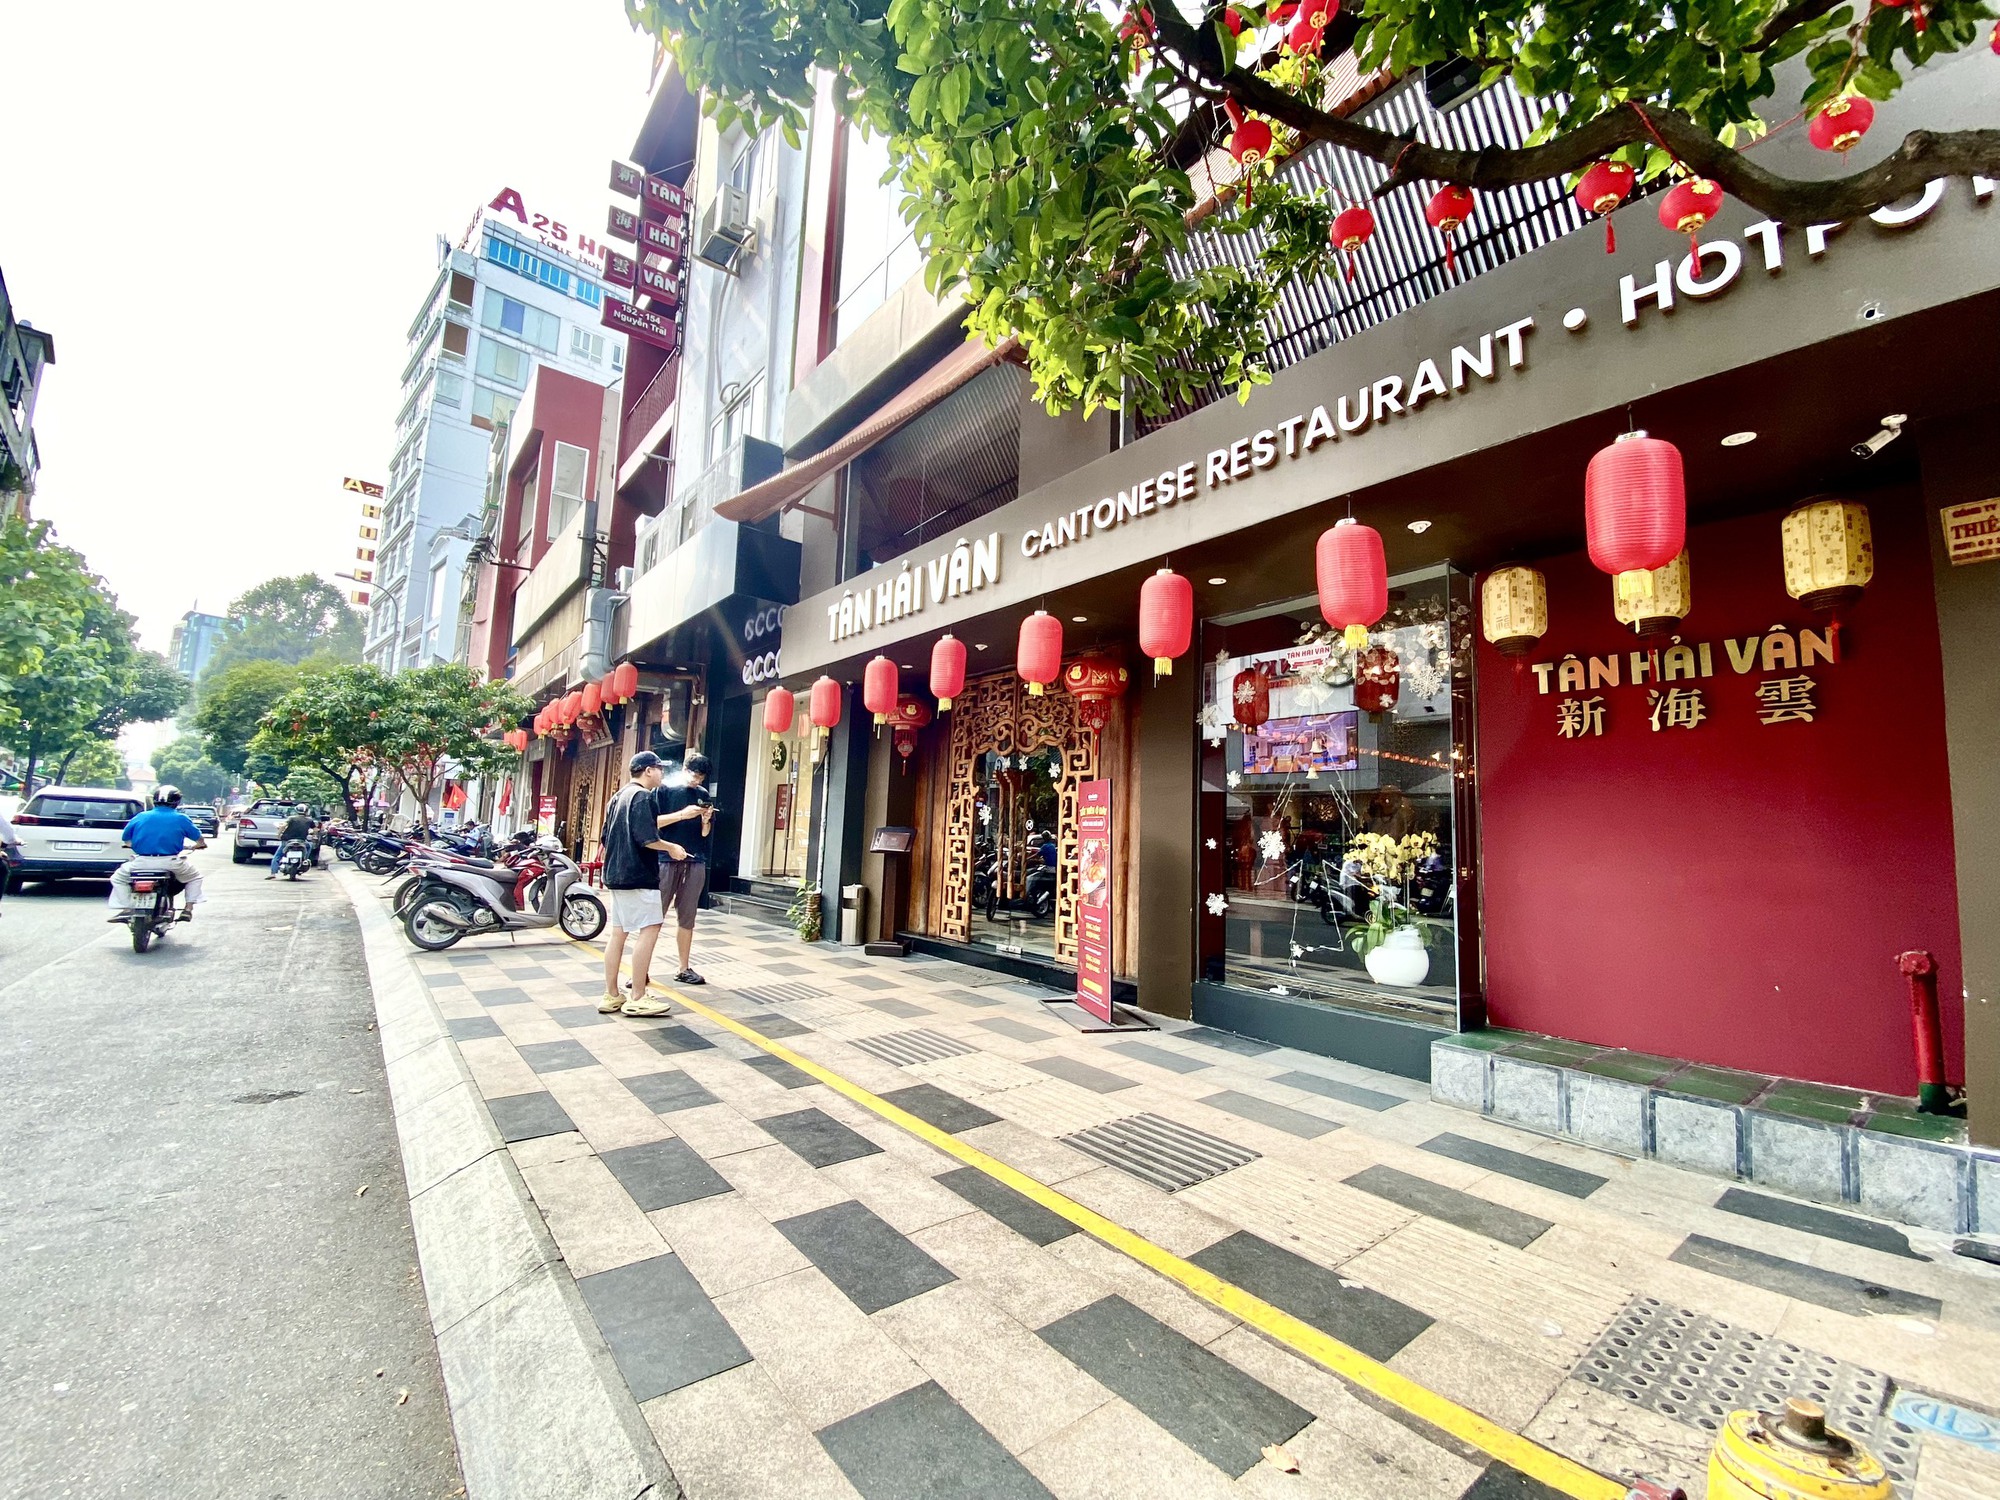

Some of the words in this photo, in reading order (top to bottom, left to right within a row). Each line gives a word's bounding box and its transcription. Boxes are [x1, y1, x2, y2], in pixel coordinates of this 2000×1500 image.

[650, 183, 680, 206] TÂN
[1618, 177, 1996, 327] HOTO
[643, 269, 677, 294] VÂN
[621, 304, 638, 316] 152
[645, 313, 661, 325] 154
[1020, 461, 1196, 558] CANTONESE
[1205, 316, 1535, 488] RESTAURANT
[344, 478, 383, 498] A25
[827, 588, 875, 642] TÂN
[876, 560, 926, 625] HẢI
[928, 531, 1000, 603] VÂN
[1531, 653, 1620, 695] TÂN
[1630, 635, 1714, 685] HẢI
[1723, 624, 1837, 674] VÂN
